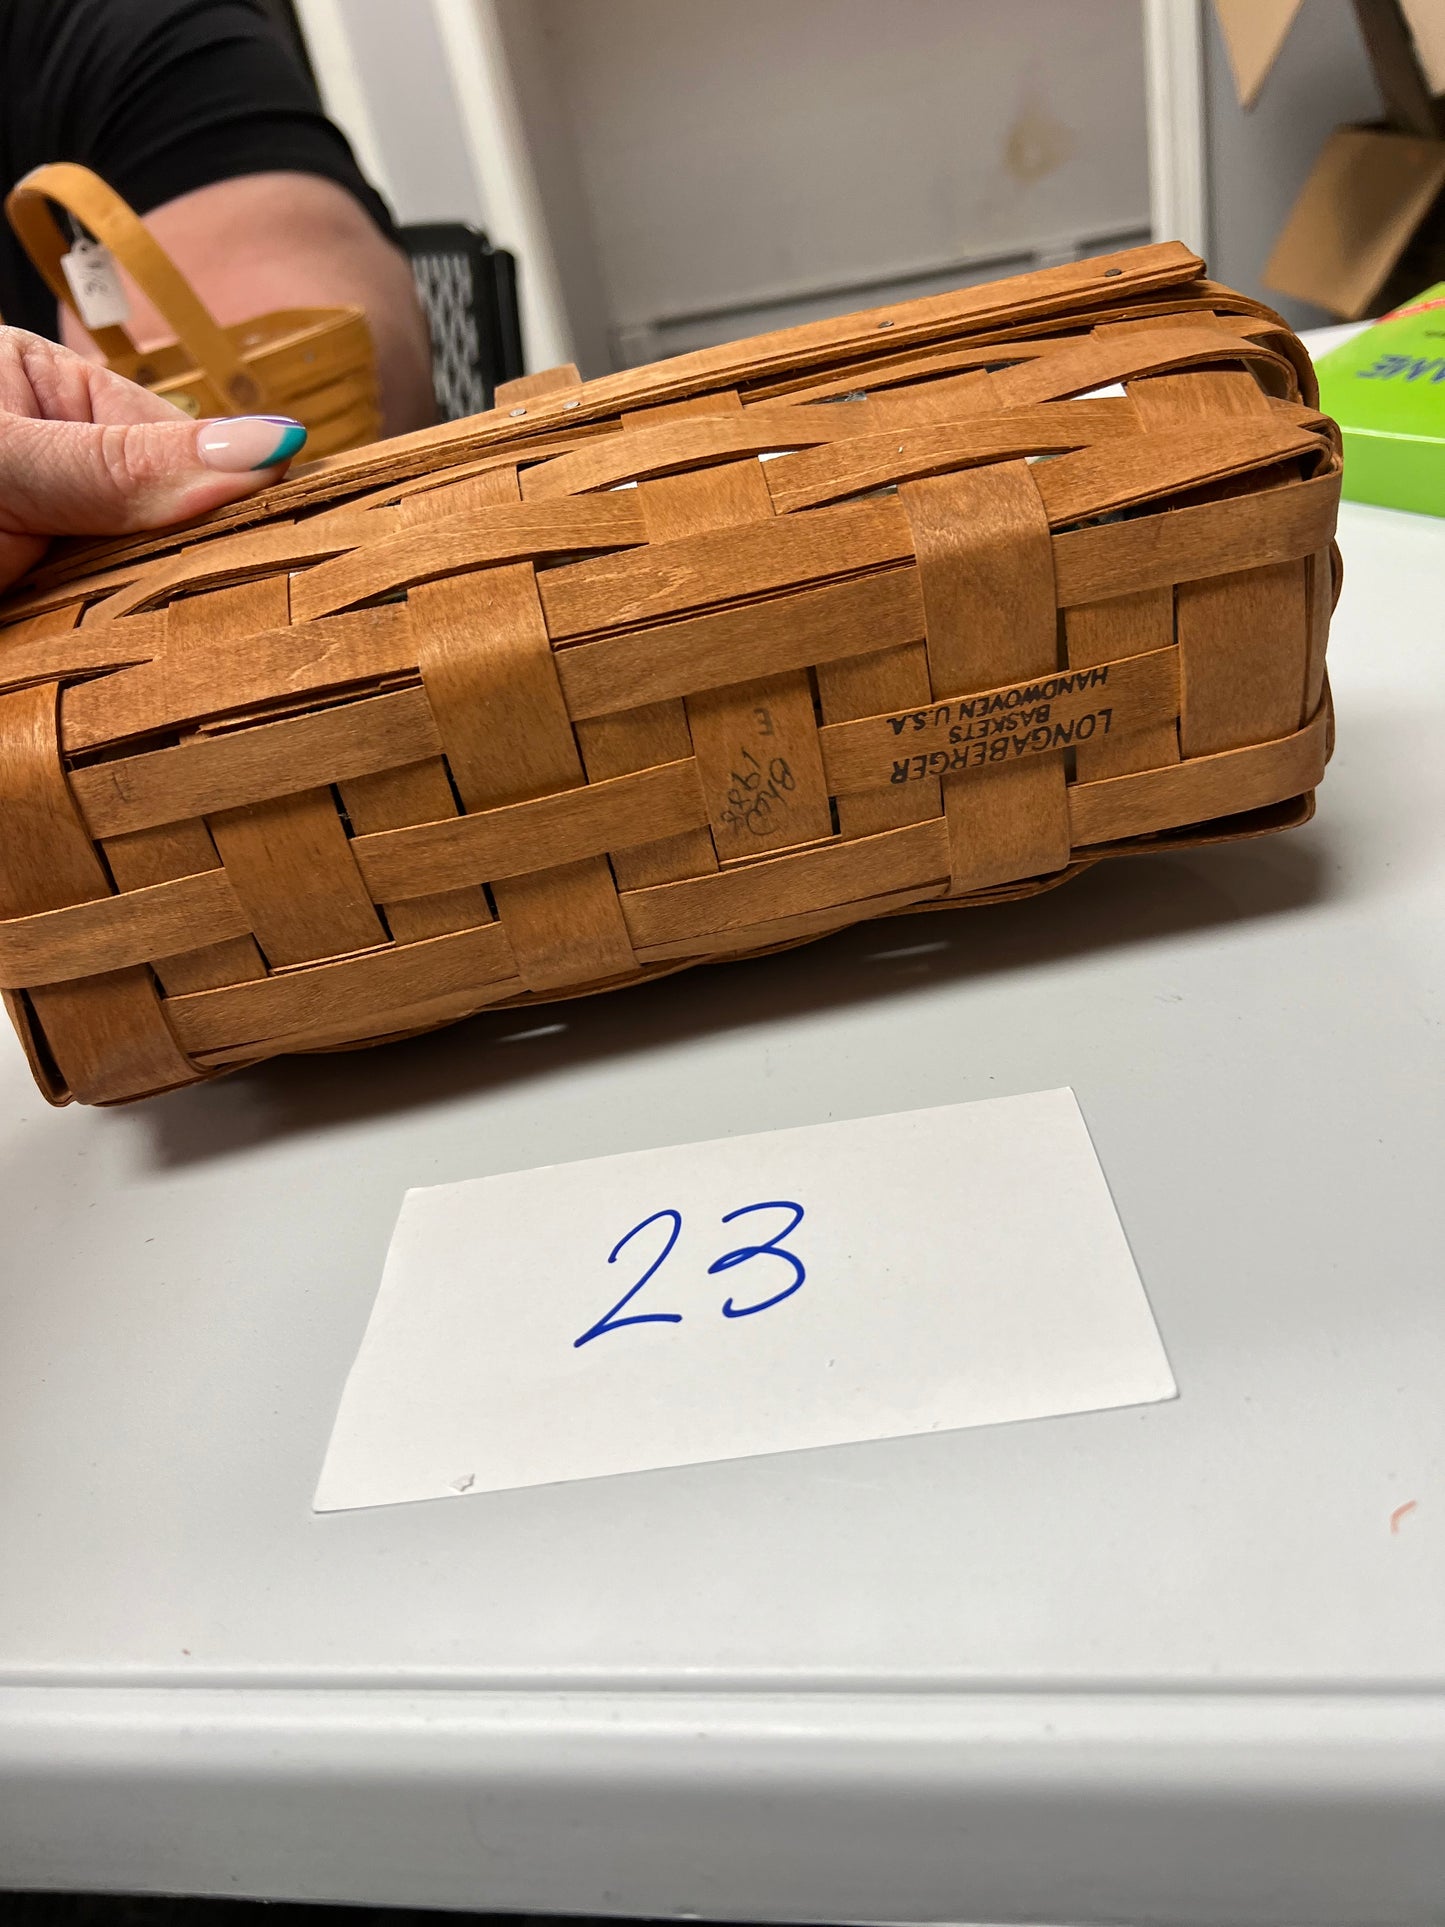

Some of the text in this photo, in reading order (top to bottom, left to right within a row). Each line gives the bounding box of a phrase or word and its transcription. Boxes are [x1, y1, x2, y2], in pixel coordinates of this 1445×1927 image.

[949, 703, 1052, 745] BASKETS
[959, 665, 1109, 721] HANDWOVEN
[890, 708, 1113, 785] LONGABERGER
[572, 1200, 807, 1348] 23
